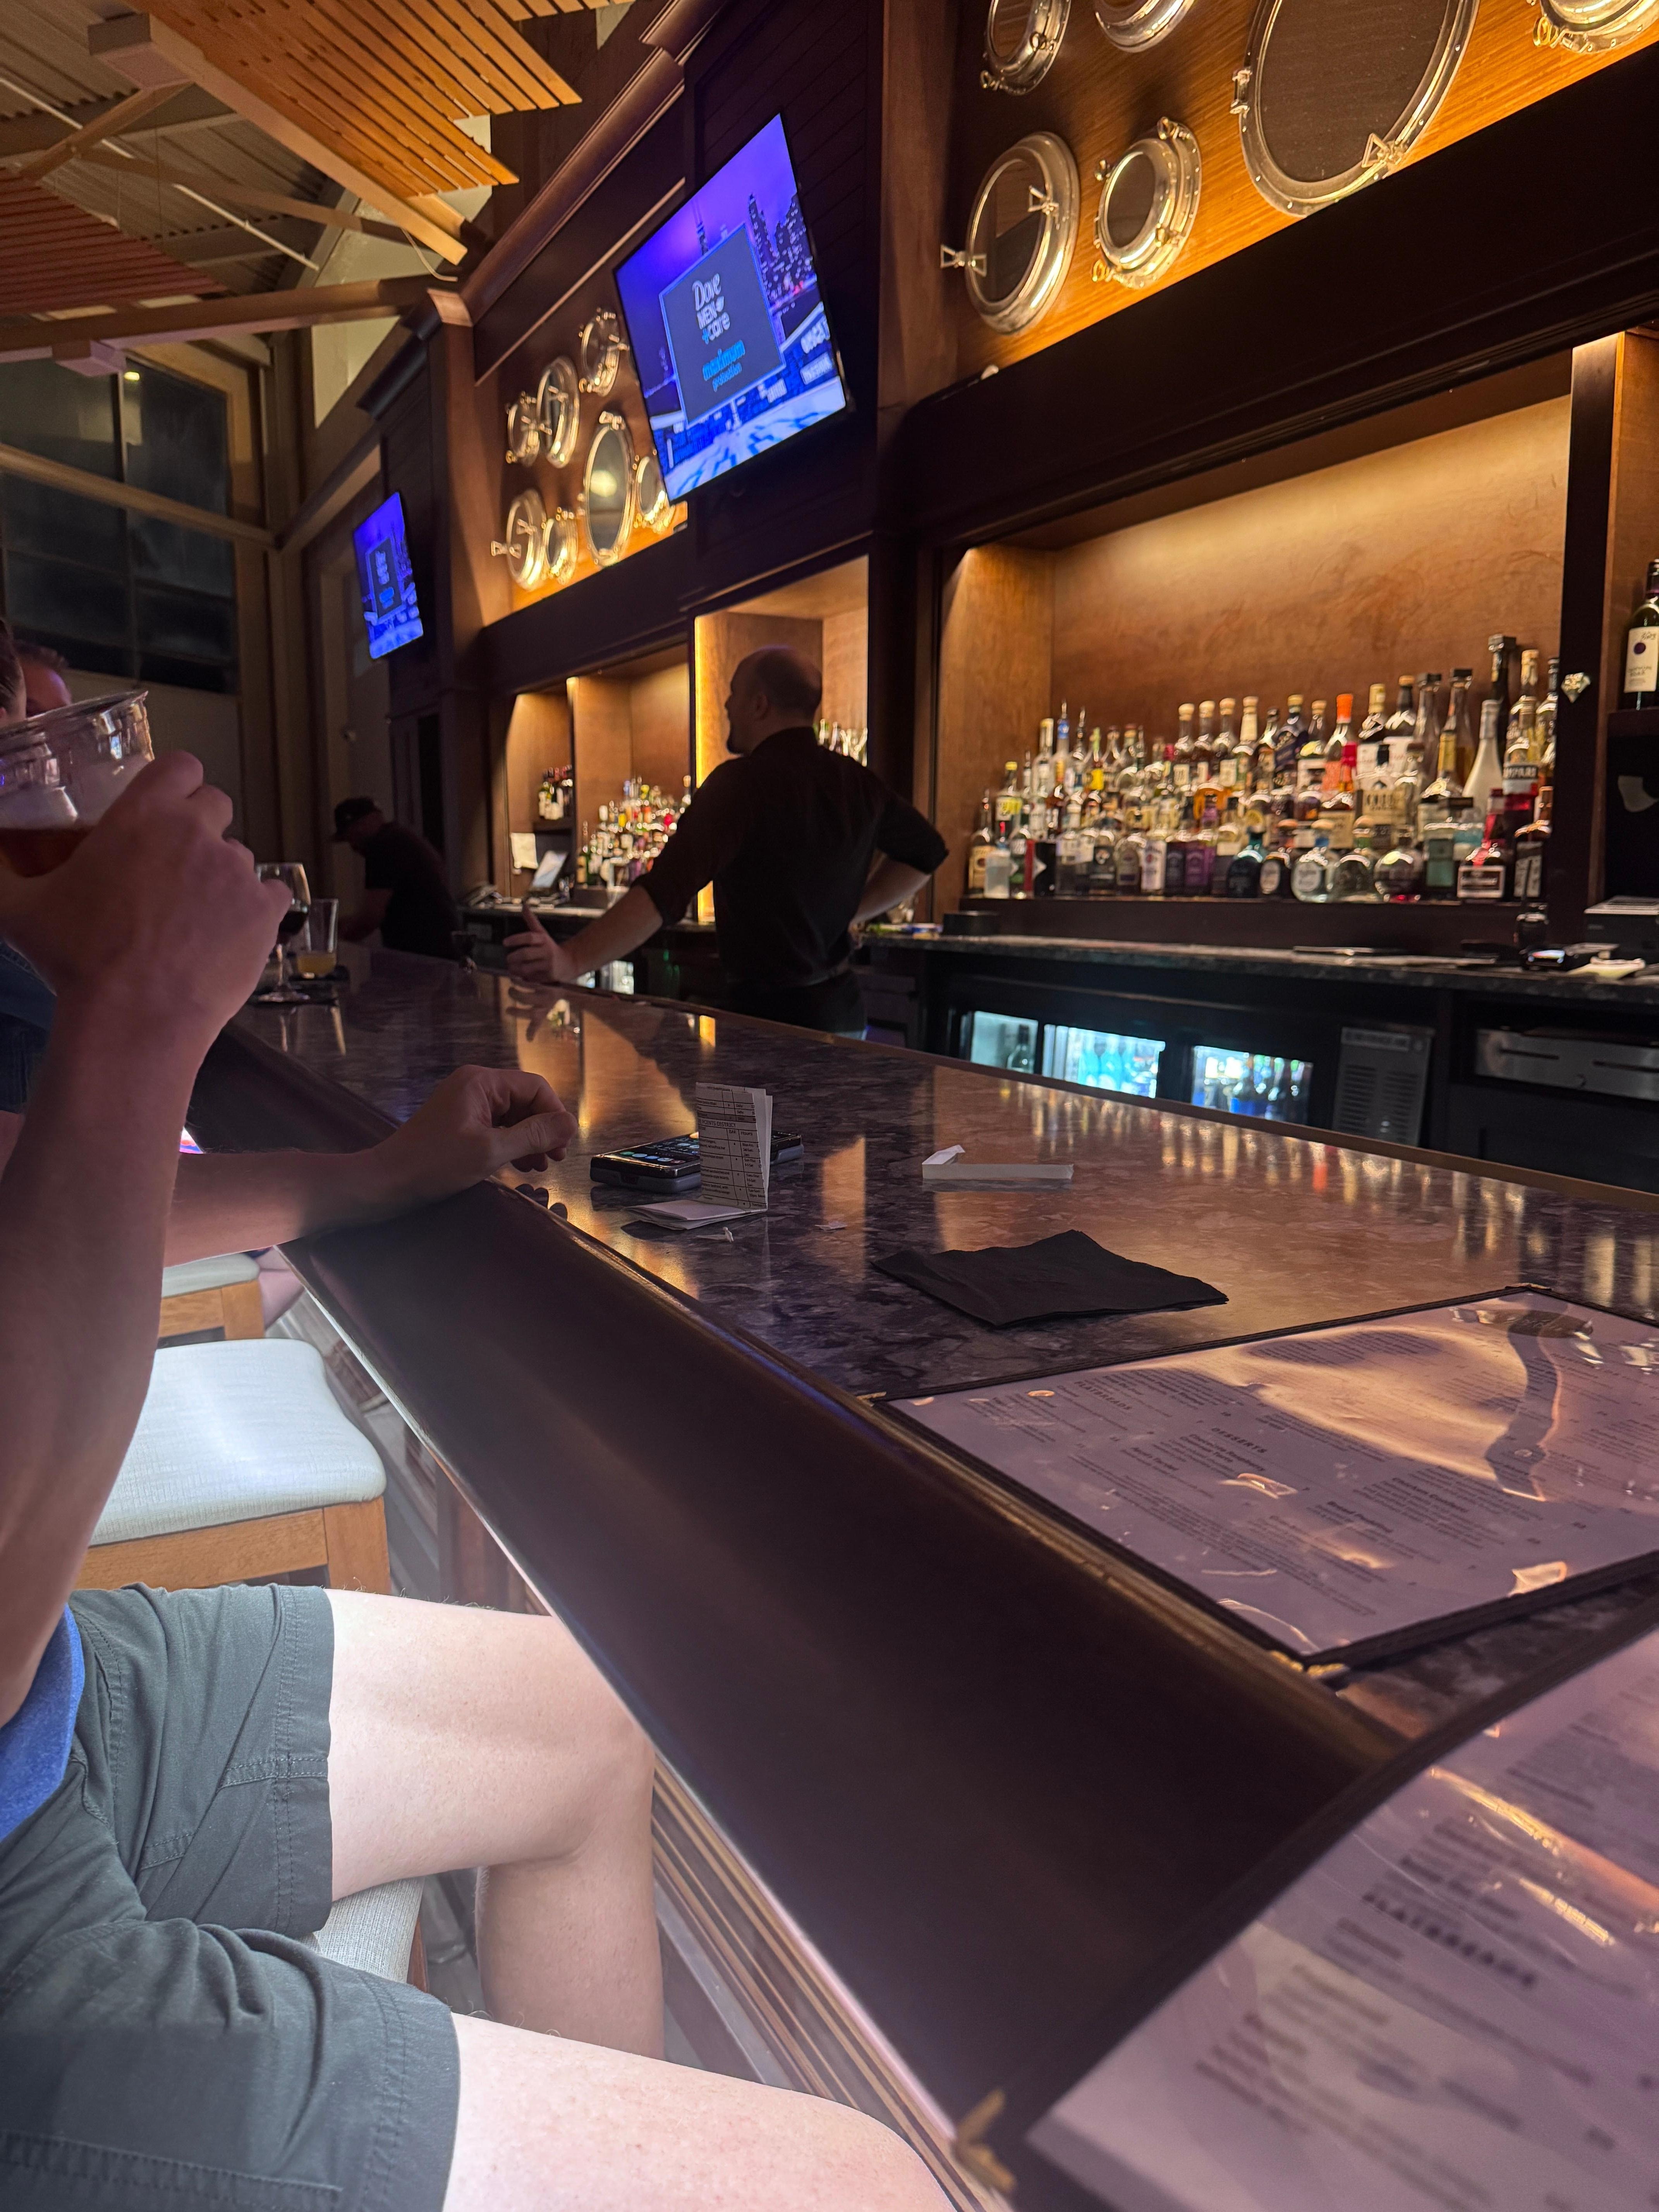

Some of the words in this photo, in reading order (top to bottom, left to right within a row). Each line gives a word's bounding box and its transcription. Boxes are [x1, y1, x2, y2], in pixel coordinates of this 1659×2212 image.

[692, 273, 721, 311] Dove
[697, 301, 717, 329] MEN
[1073, 1381, 1134, 1410] FLATBREADS
[1211, 1427, 1267, 1453] DESSERTS
